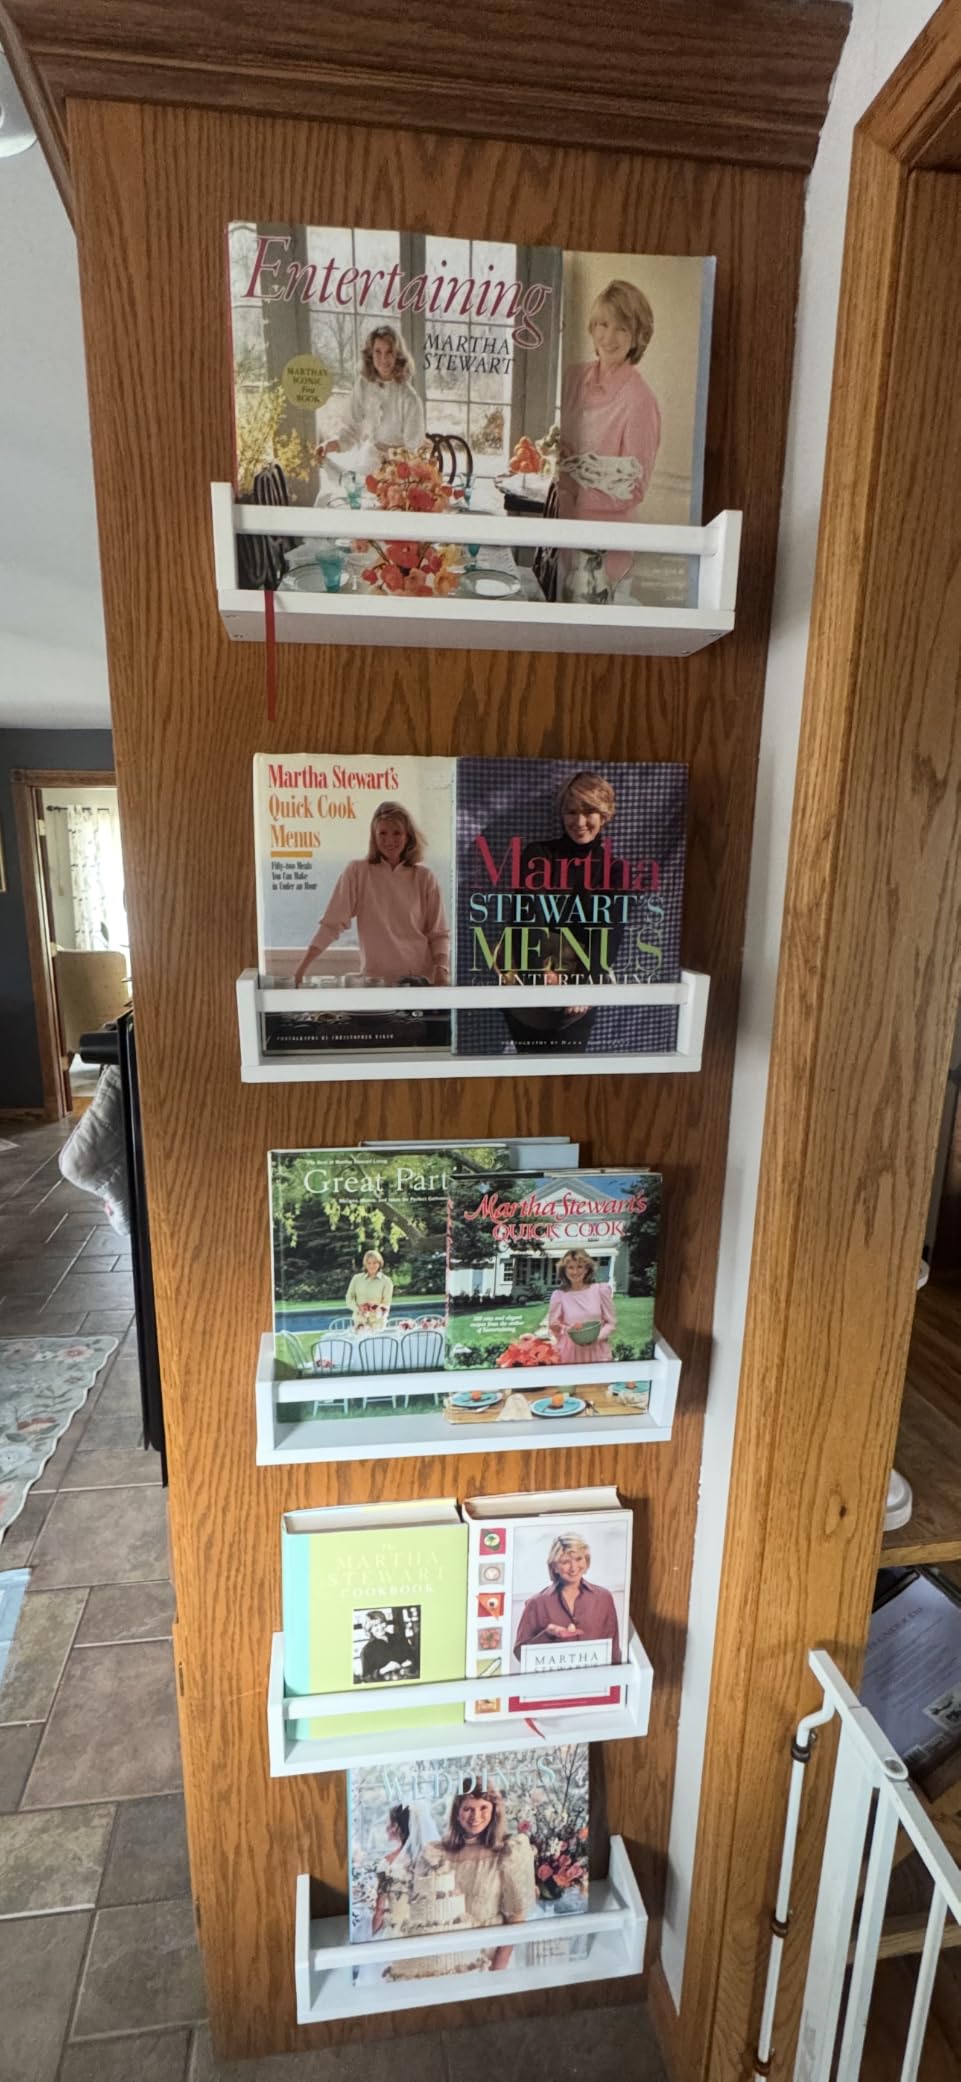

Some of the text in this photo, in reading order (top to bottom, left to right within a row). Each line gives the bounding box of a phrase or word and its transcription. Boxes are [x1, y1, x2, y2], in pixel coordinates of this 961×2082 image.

[240, 236, 552, 349] Entertaining
[424, 333, 510, 355] MARTHA
[423, 353, 515, 374] STEWART
[268, 764, 399, 790] Martha Stewart's
[268, 794, 356, 821] Quick Cook
[270, 824, 321, 848] Menus
[470, 834, 662, 891] Martha
[271, 871, 309, 881] You Can Make
[469, 892, 665, 924] STEWART'S
[468, 926, 663, 972] MENUS
[303, 1168, 385, 1194] Great
[464, 1190, 648, 1223] Martha Stewart's
[492, 1220, 626, 1242] QUICK COOK
[336, 1551, 440, 1570] MARTHA
[327, 1566, 446, 1586] STEWART
[340, 1583, 434, 1599] COOKBOOK
[534, 1651, 599, 1666] MARTHA
[383, 1755, 557, 1801] WEDDINGS
